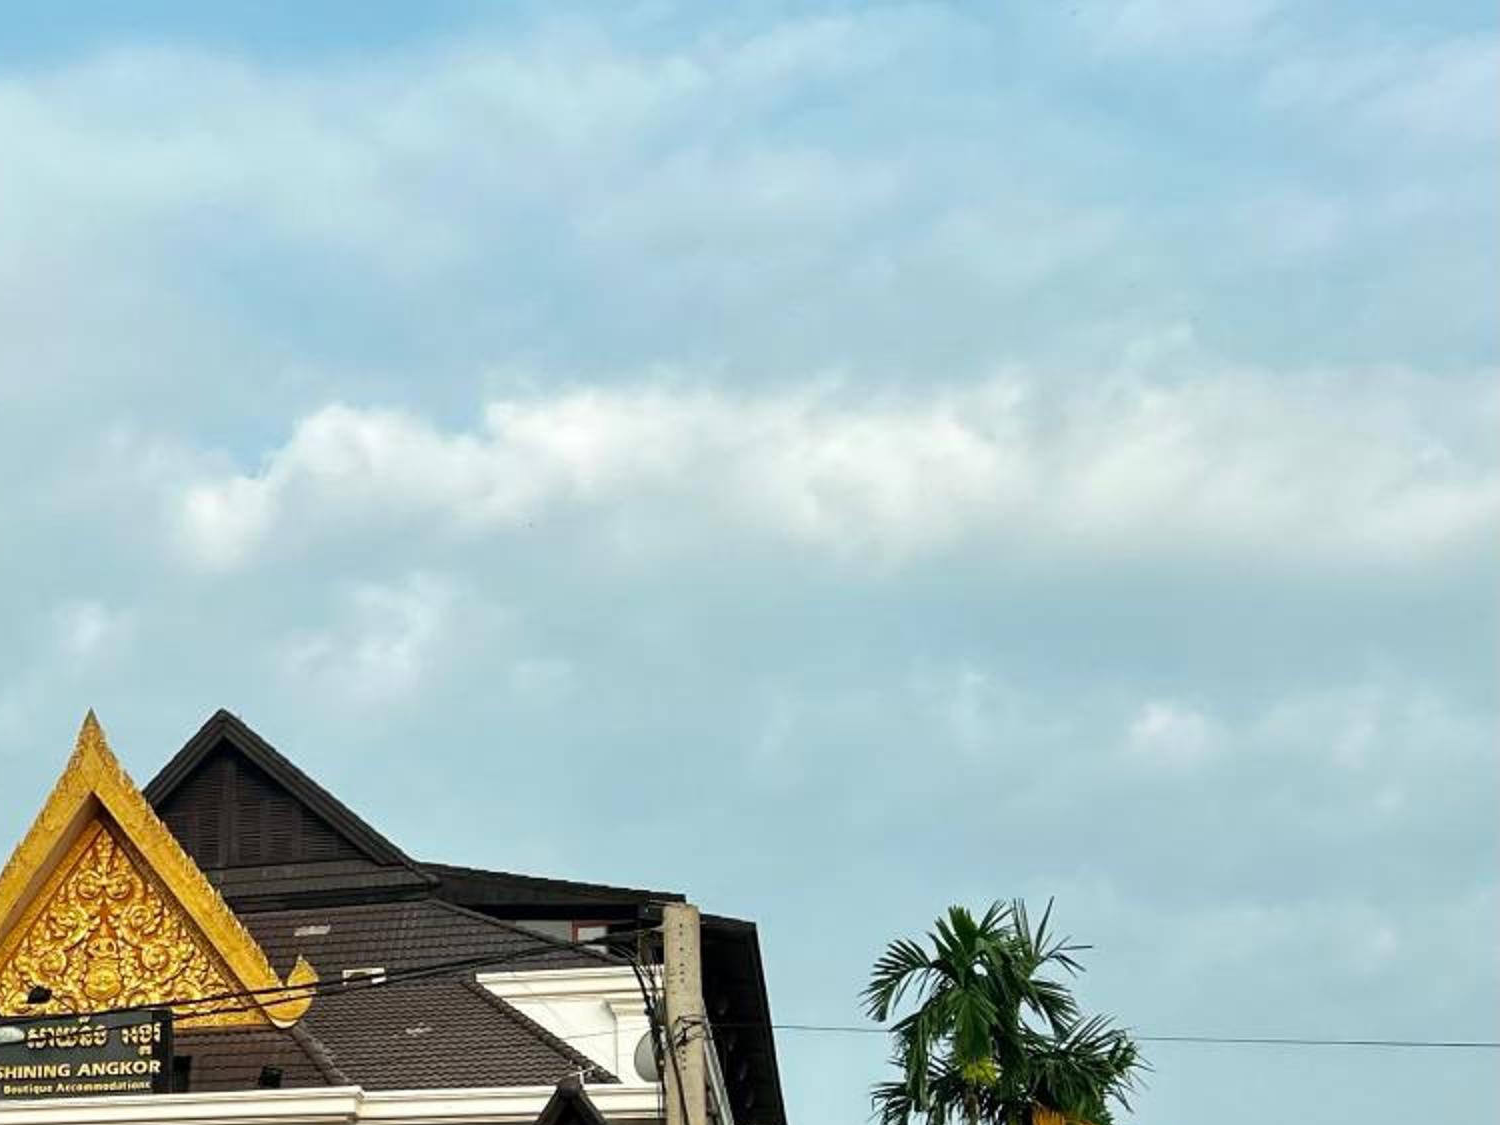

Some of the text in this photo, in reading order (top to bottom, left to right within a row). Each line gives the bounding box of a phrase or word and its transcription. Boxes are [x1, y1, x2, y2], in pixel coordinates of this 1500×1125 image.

[77, 1060, 162, 1077] ANGKOR
[3, 1080, 152, 1096] Boutique Accommodations
